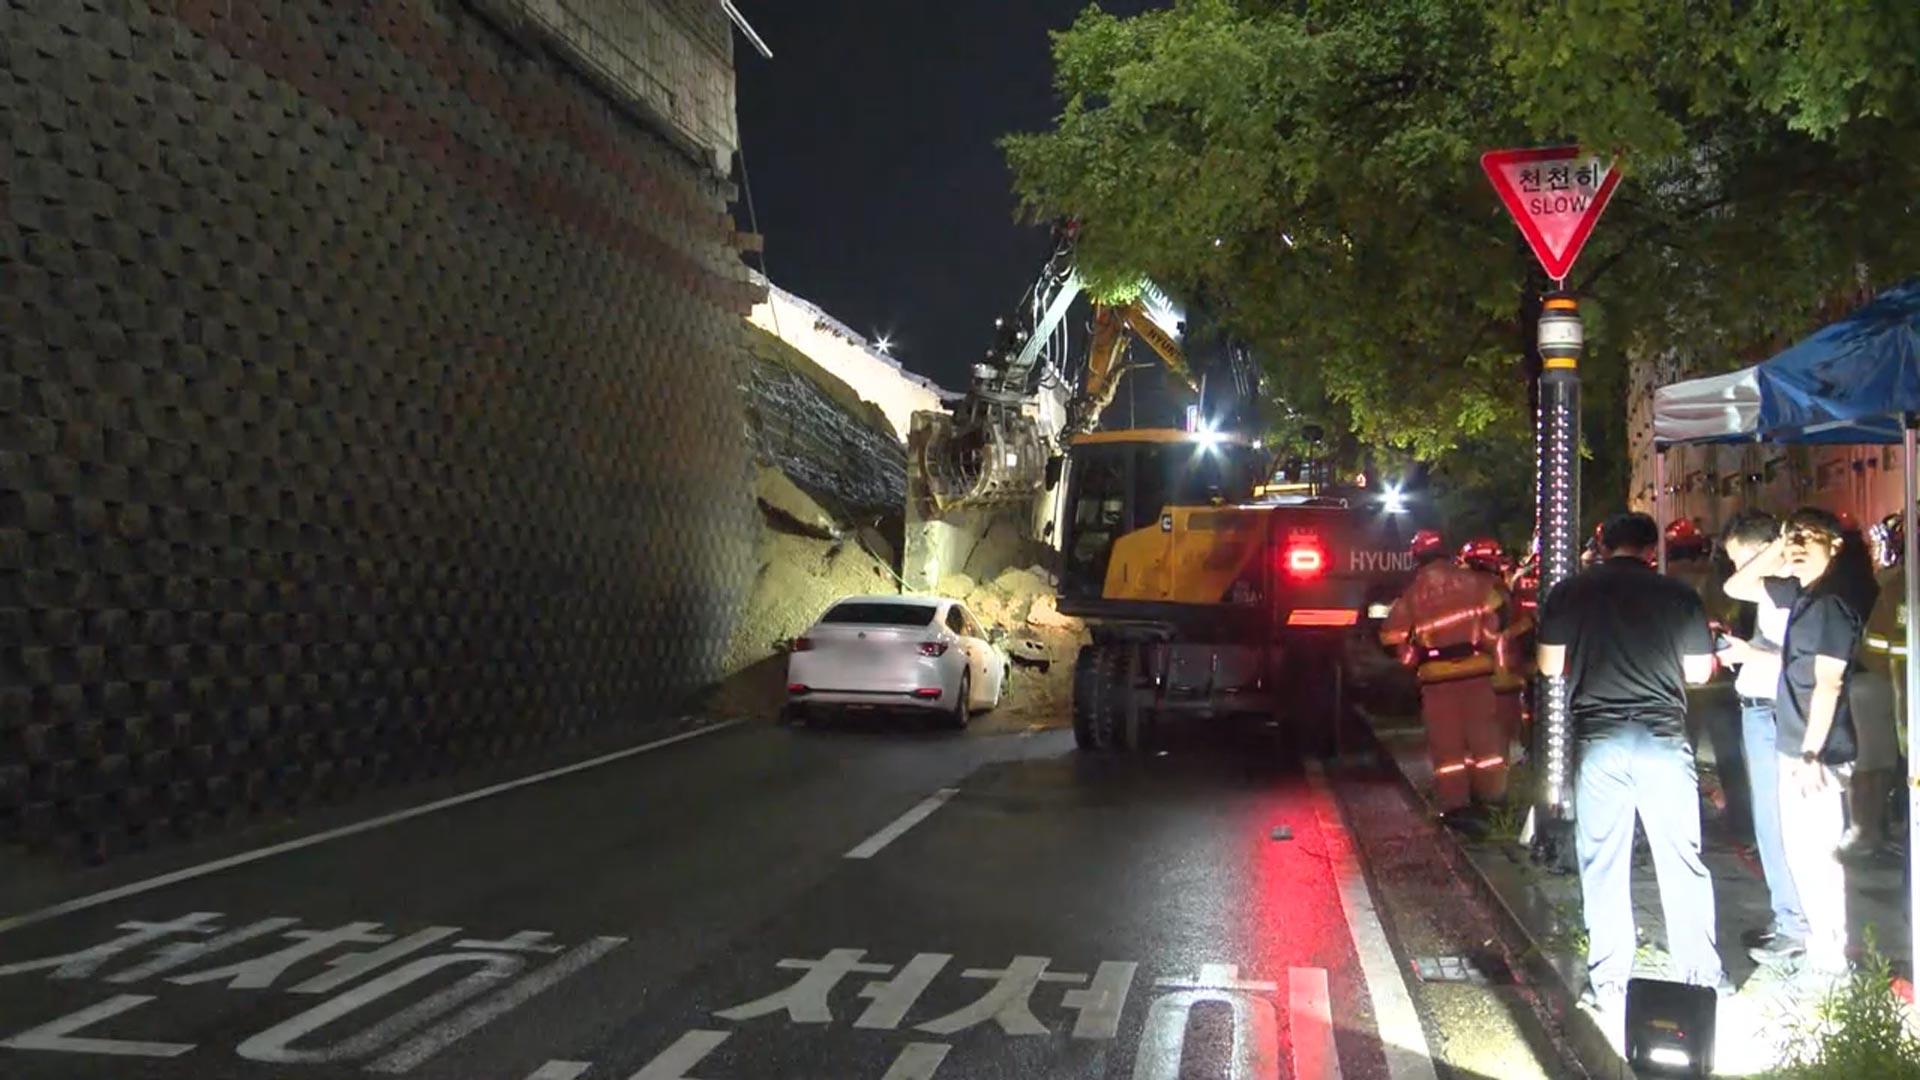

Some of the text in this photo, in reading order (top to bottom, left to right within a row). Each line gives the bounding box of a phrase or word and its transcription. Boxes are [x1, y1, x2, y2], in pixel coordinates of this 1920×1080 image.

[1519, 162, 1598, 193] 천천히
[1530, 196, 1587, 215] SLOW
[1147, 328, 1181, 359] HYUN
[1349, 550, 1418, 572] HYUND
